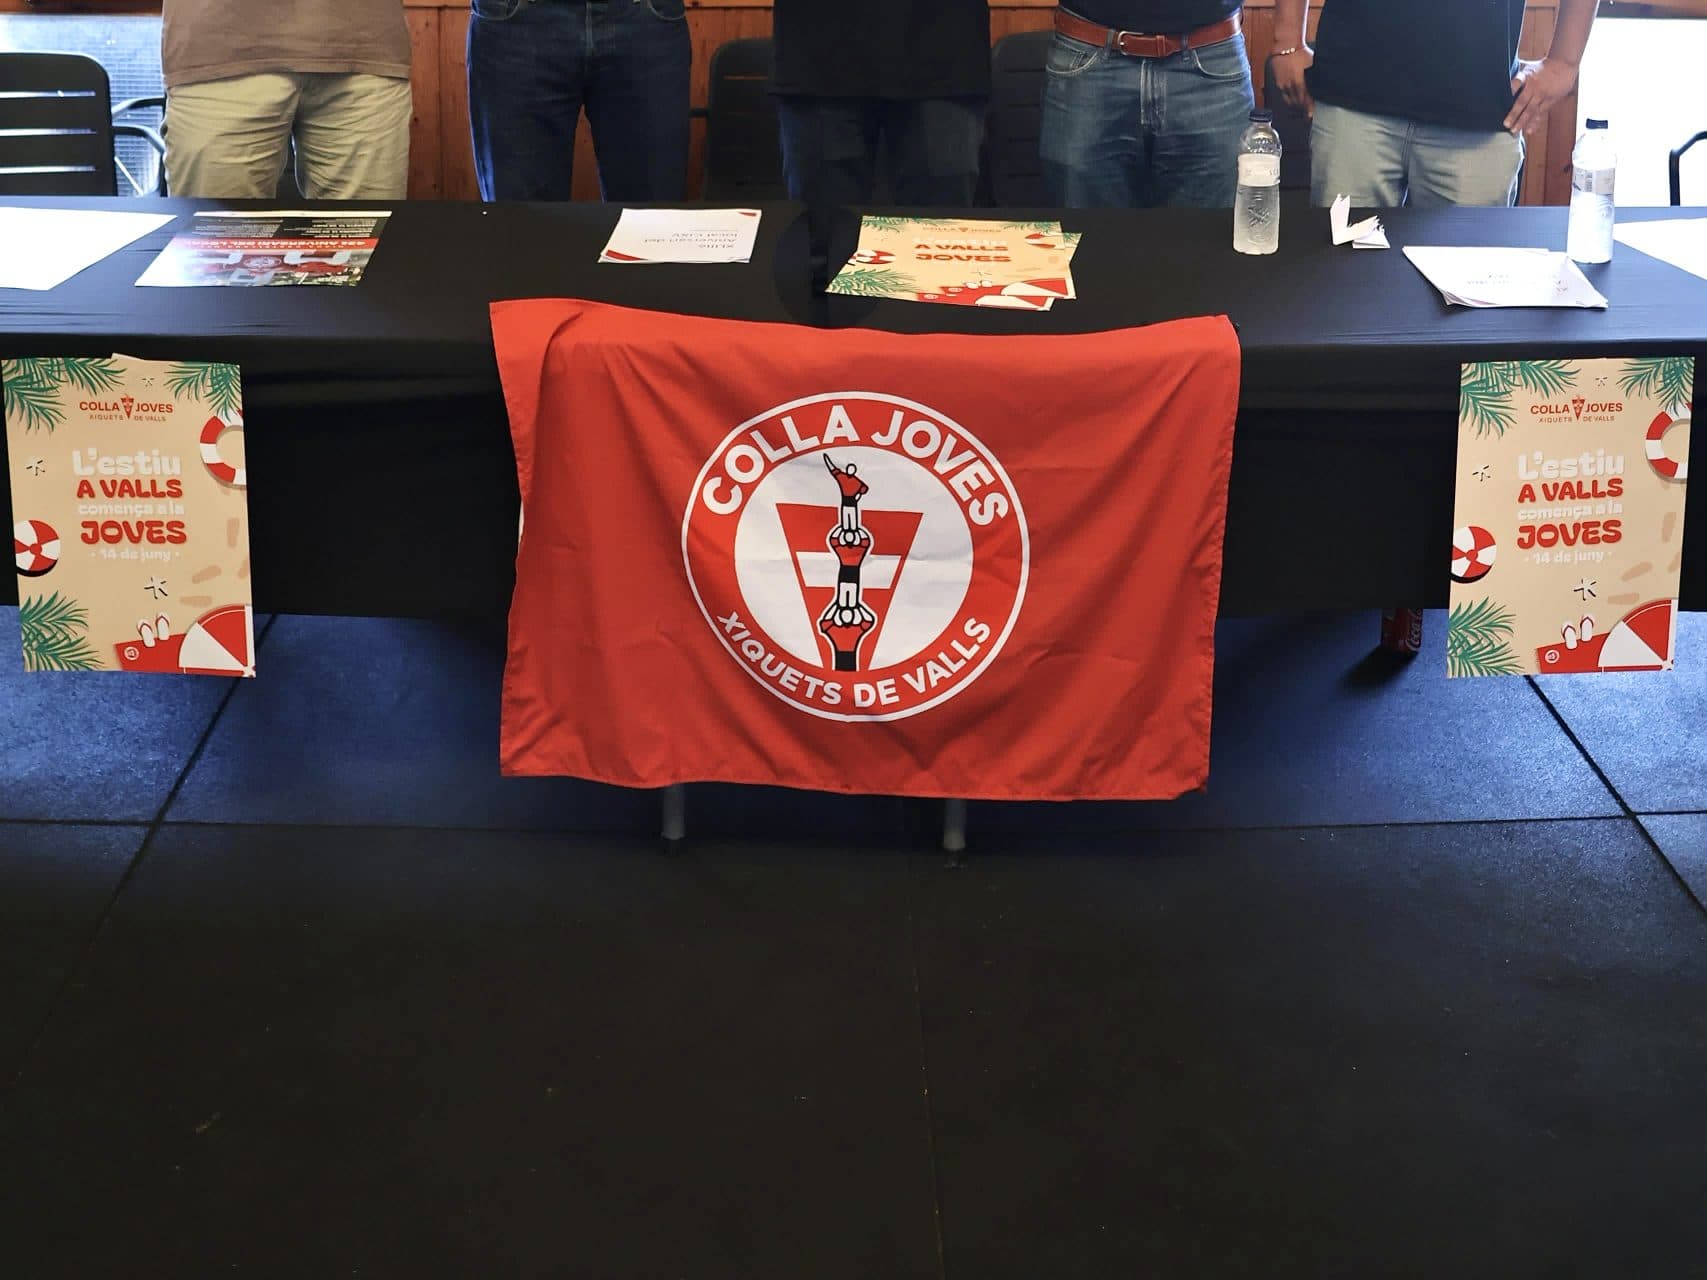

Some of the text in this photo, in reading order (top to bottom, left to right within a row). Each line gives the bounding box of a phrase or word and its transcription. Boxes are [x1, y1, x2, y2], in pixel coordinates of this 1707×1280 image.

[915, 253, 1012, 263] JOVES
[935, 244, 1009, 252] VALLS
[79, 401, 174, 414] COLLA JOVES
[1530, 402, 1624, 415] COLLA JOVES
[71, 447, 181, 476] L'estiu
[702, 405, 1010, 527] COLLA JOVES
[1518, 449, 1625, 481] L'estiu
[76, 479, 183, 499] A VALLS
[1517, 478, 1624, 504] A VALLS
[80, 520, 188, 545] JOVES
[1517, 519, 1623, 550] JOVES
[717, 611, 991, 708] XIQUETS DE VALLS
